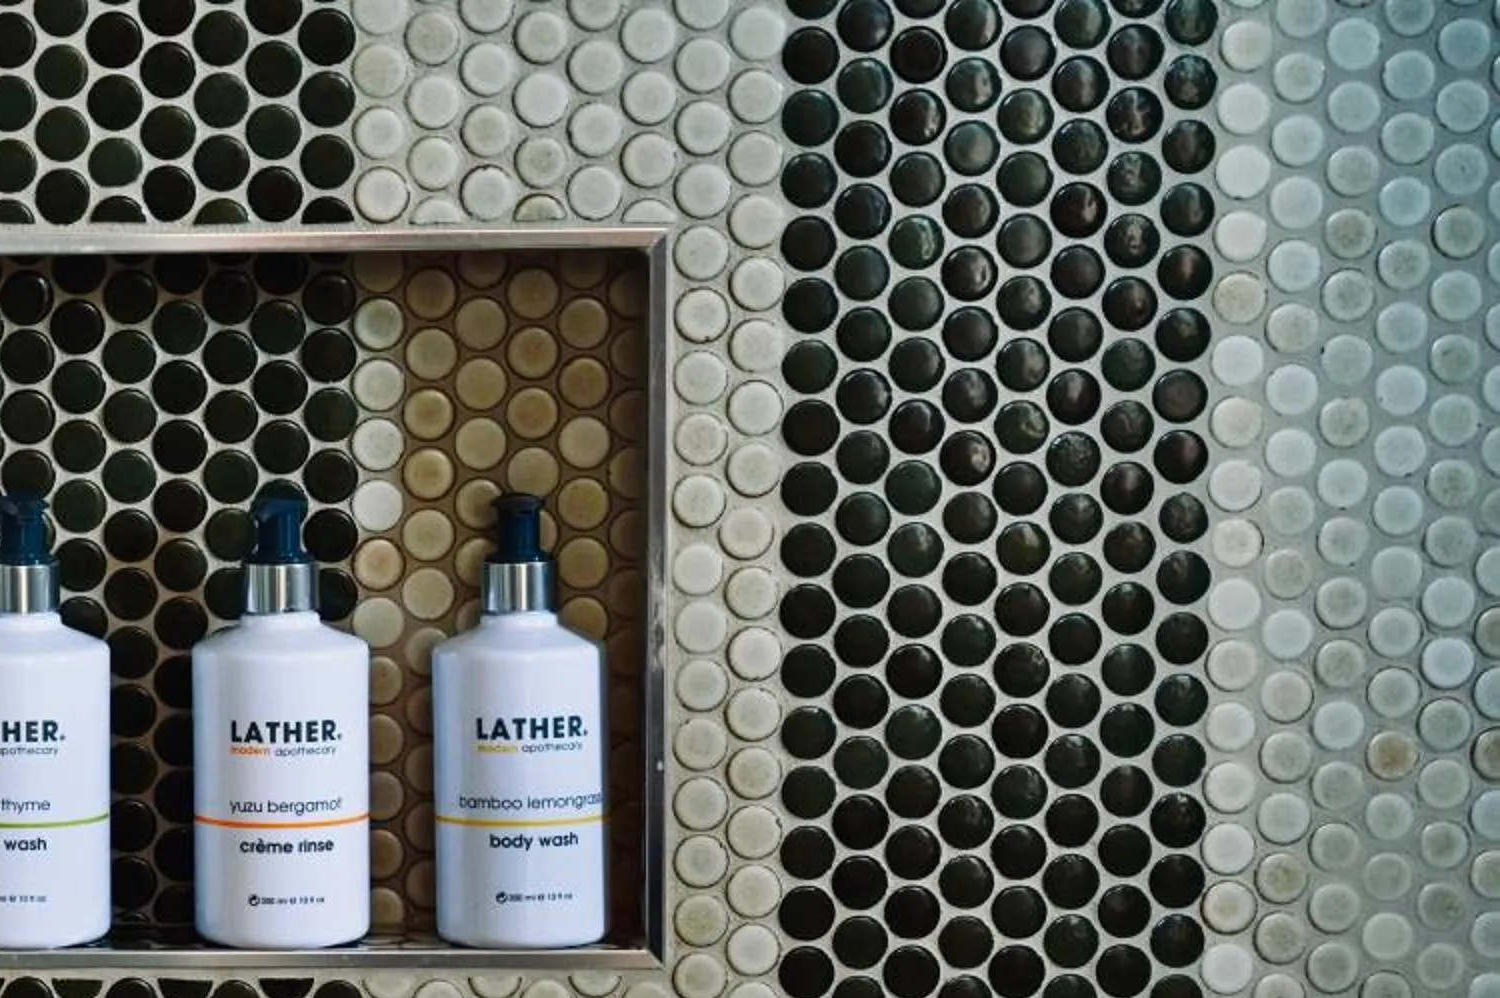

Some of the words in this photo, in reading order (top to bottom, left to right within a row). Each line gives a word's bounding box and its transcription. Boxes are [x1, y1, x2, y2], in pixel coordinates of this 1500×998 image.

[230, 719, 343, 743] LATHER.
[476, 716, 588, 740] LATHER.
[1, 798, 51, 815] thyme
[229, 800, 263, 814] yuzu
[267, 797, 342, 816] bergamot
[459, 795, 523, 811] bamboo
[4, 837, 48, 851] wash
[239, 838, 294, 854] crème
[299, 839, 335, 853] rinse
[489, 834, 533, 851] body
[539, 832, 579, 847] wash
